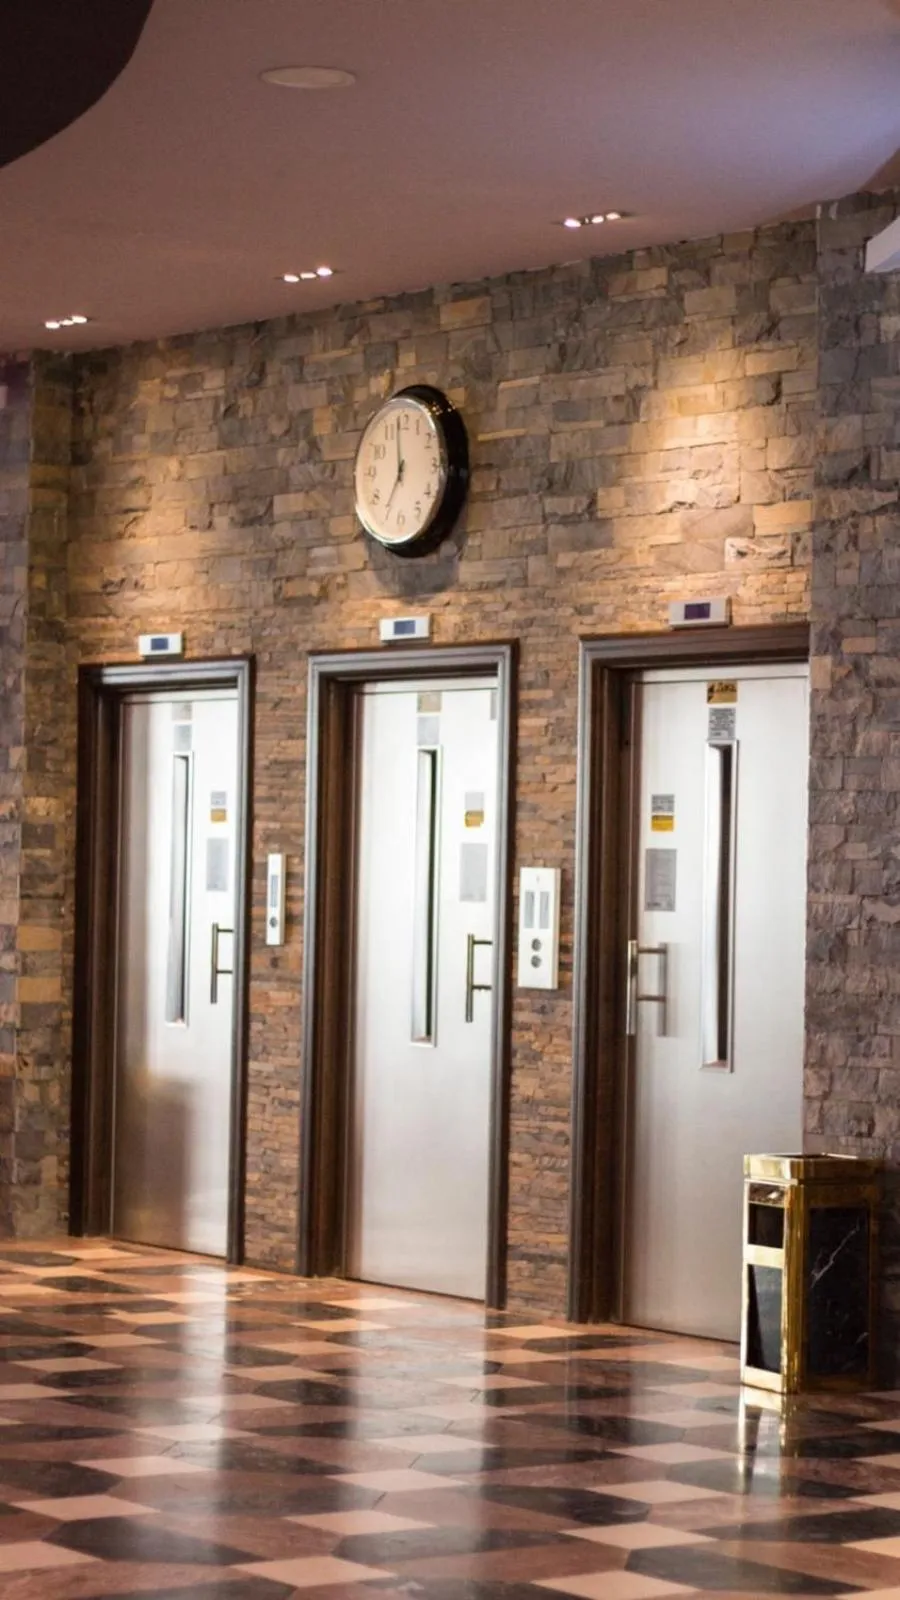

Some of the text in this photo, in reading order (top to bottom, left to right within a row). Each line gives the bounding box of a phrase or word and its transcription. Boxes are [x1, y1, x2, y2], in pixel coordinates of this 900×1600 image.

[384, 422, 395, 441] 11
[424, 432, 432, 449] 2
[373, 443, 386, 461] 10
[431, 456, 438, 474] 3
[370, 487, 380, 506] 8
[423, 482, 431, 498] 4
[396, 510, 406, 526] 6
[414, 500, 422, 523] 5
